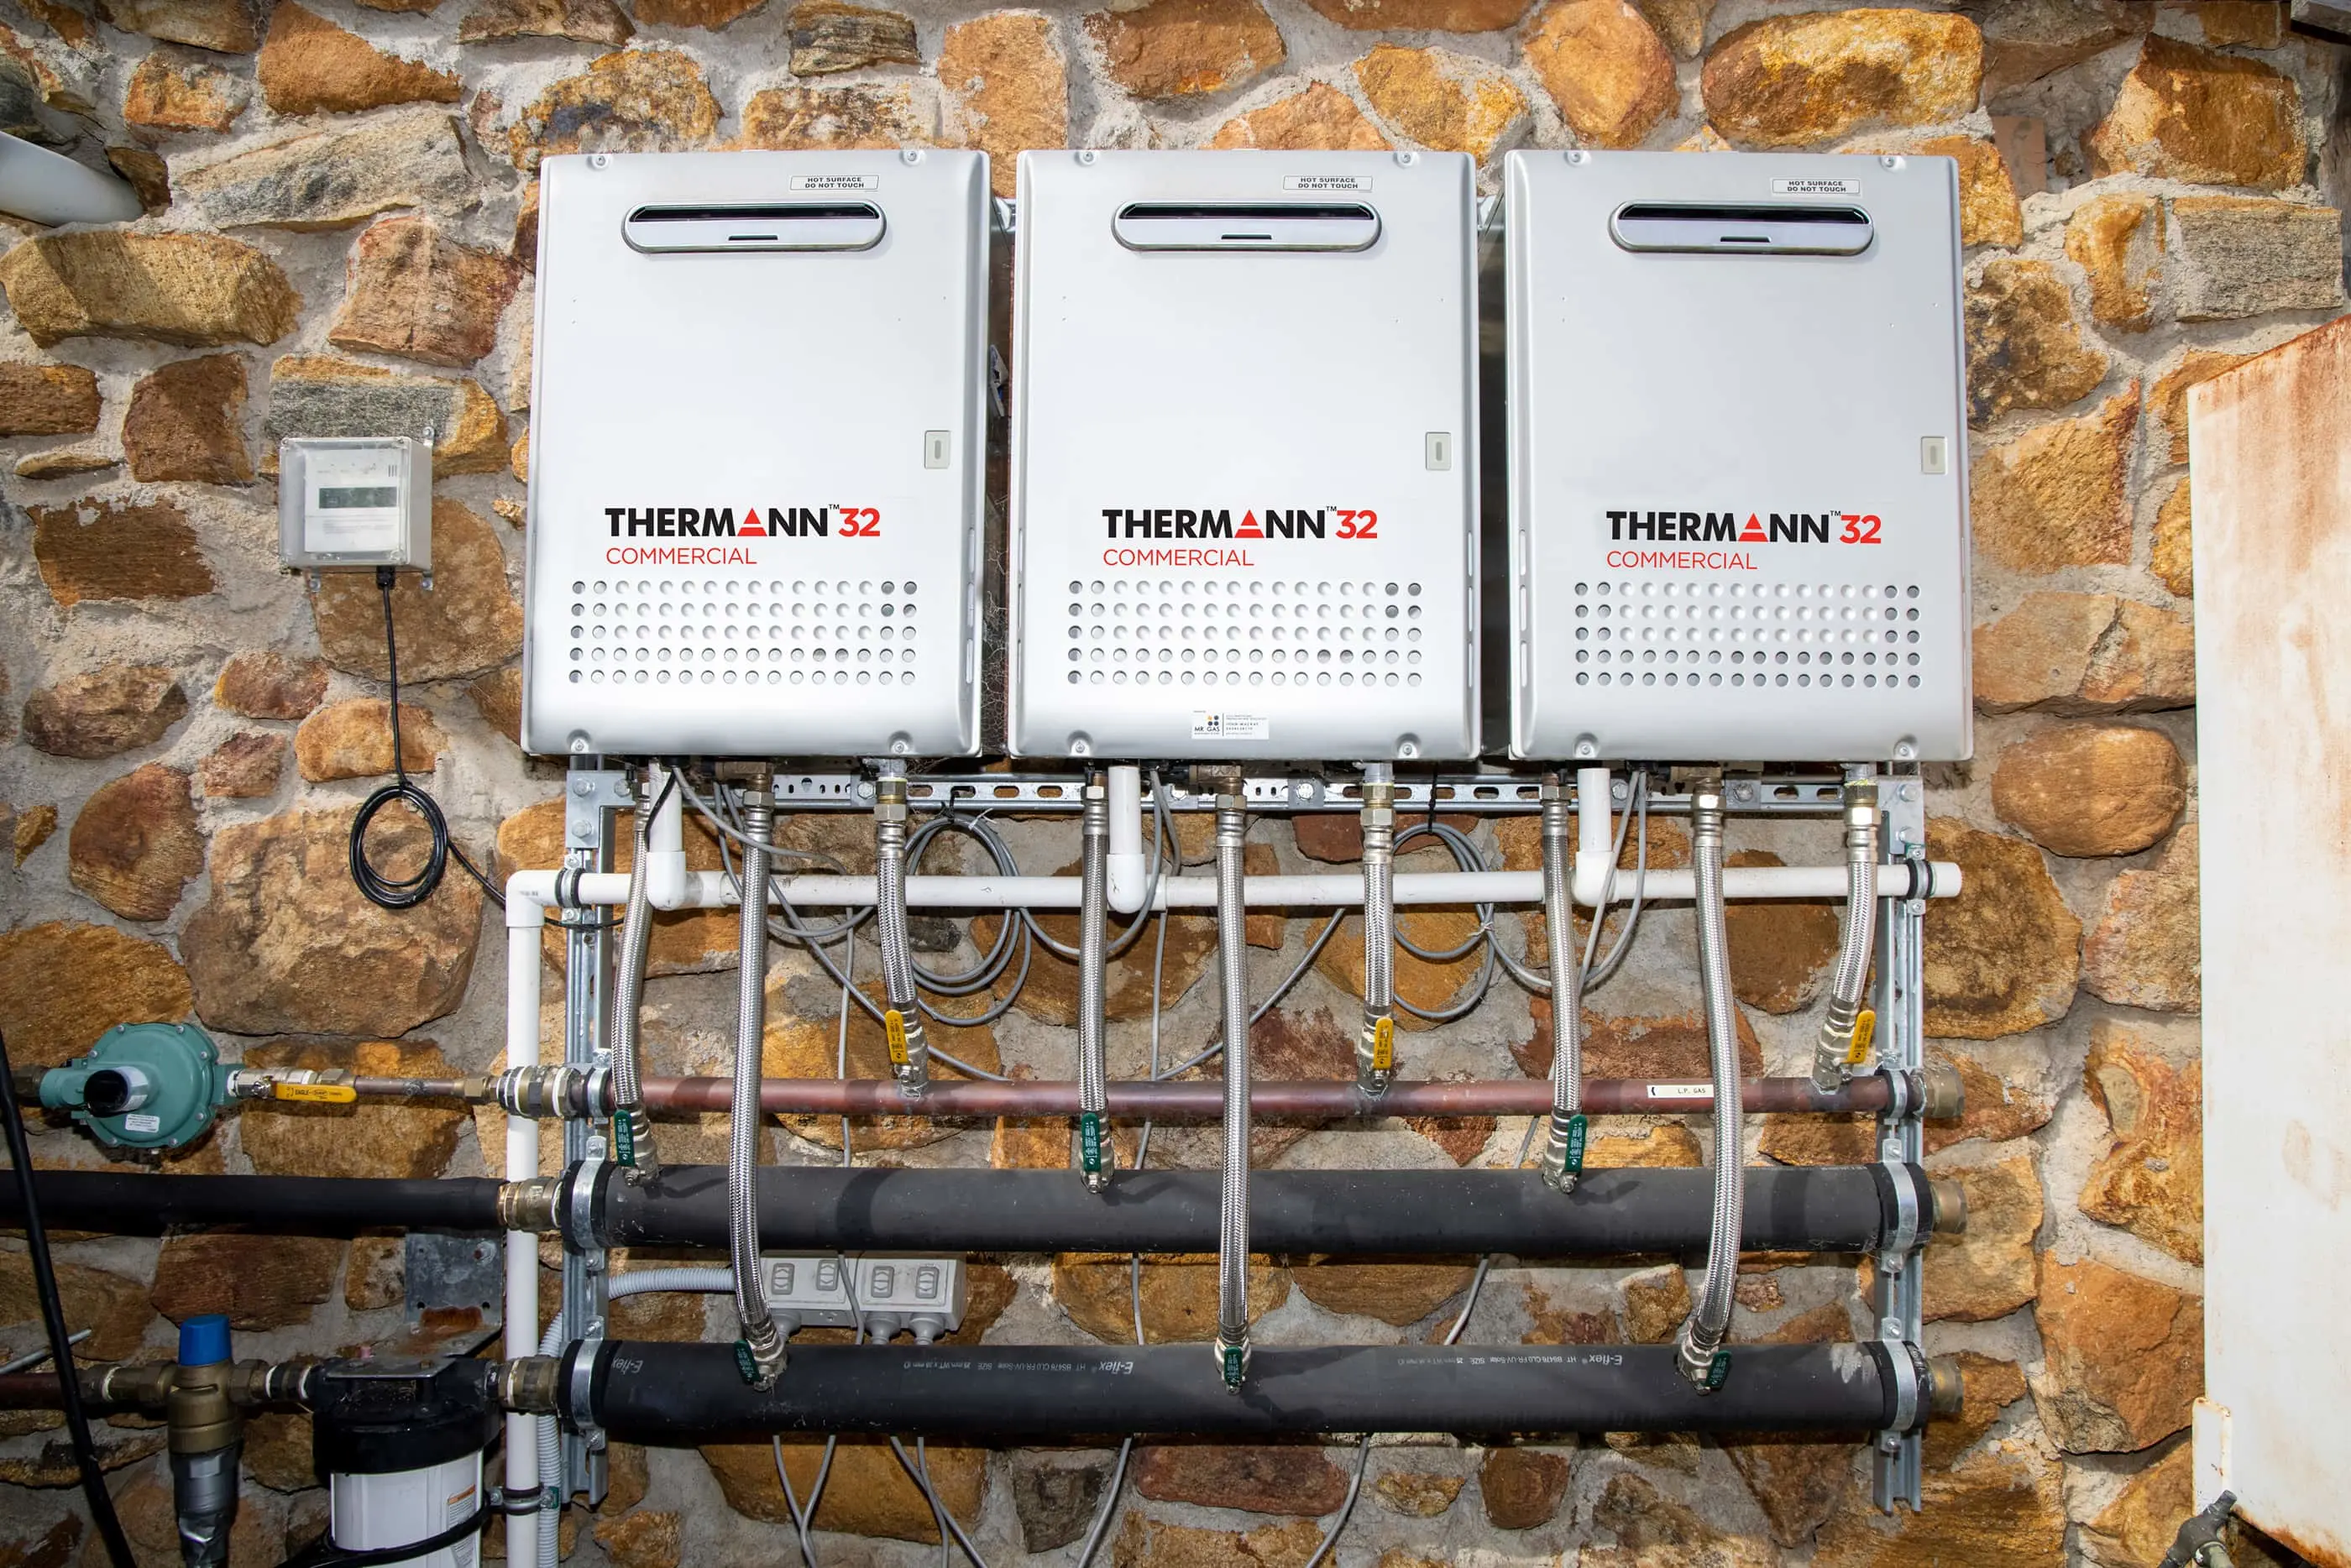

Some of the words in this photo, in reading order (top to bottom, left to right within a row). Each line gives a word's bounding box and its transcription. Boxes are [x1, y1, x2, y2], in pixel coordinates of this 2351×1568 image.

[838, 508, 881, 537] 32
[1335, 510, 1378, 539] 32
[1839, 515, 1882, 544] 32
[605, 547, 757, 565] COMMERCIAL
[1103, 549, 1254, 567] COMMERCIAL
[1606, 551, 1757, 570] COMMERCIAL
